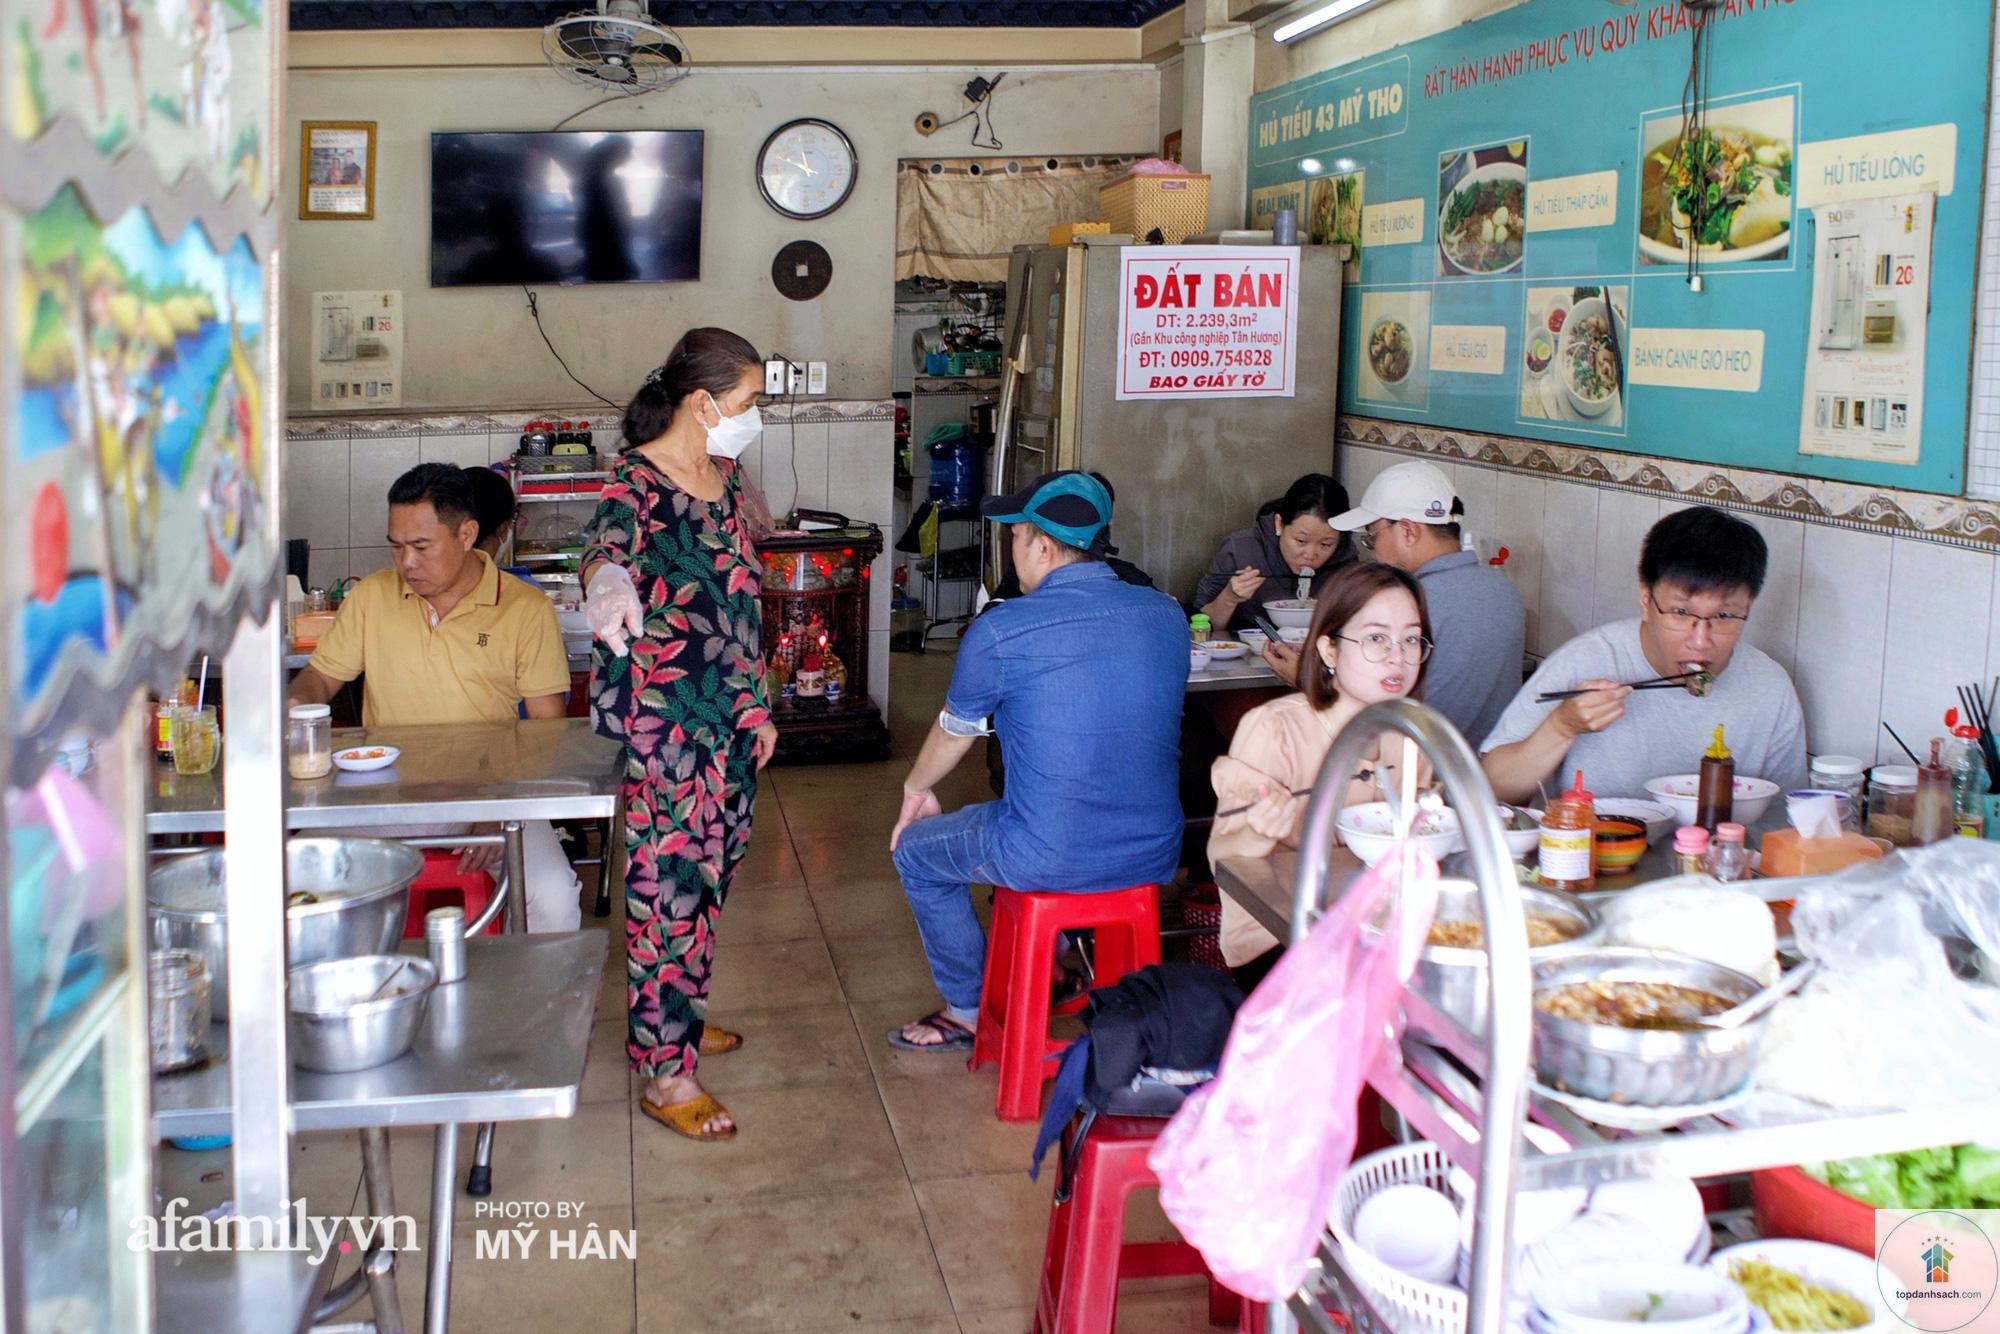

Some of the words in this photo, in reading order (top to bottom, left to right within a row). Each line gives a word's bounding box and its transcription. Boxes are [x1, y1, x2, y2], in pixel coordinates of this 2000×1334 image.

[1424, 61, 1446, 99] RẤT
[1483, 46, 1524, 87] HẠNH
[1528, 32, 1568, 73] PHỤC
[1573, 25, 1596, 63] VỤ
[1259, 109, 1278, 148] HỦ
[1281, 100, 1312, 142] TIẾU
[1315, 103, 1334, 132] 43
[1367, 83, 1403, 120] THO
[1824, 154, 1845, 185] HỦ
[1848, 152, 1878, 183] TIẾU
[1883, 150, 1925, 180] LÒNG
[1134, 262, 1201, 308] ĐẤT
[1213, 266, 1282, 308] BÁN
[1156, 314, 1181, 328] DT:
[1154, 332, 1172, 345] Khu
[1175, 332, 1196, 347] công
[1199, 331, 1229, 347] nghiệp
[1232, 330, 1248, 344] Tân
[1251, 331, 1282, 346] Hương)
[1139, 351, 1165, 368] ĐT:
[1170, 350, 1272, 367] 0909.754828
[1665, 347, 1697, 369] CANH
[1725, 350, 1752, 372] HEO
[1149, 375, 1188, 388] BAO
[1193, 368, 1238, 388] GIẤY
[1242, 371, 1267, 387] TỜ
